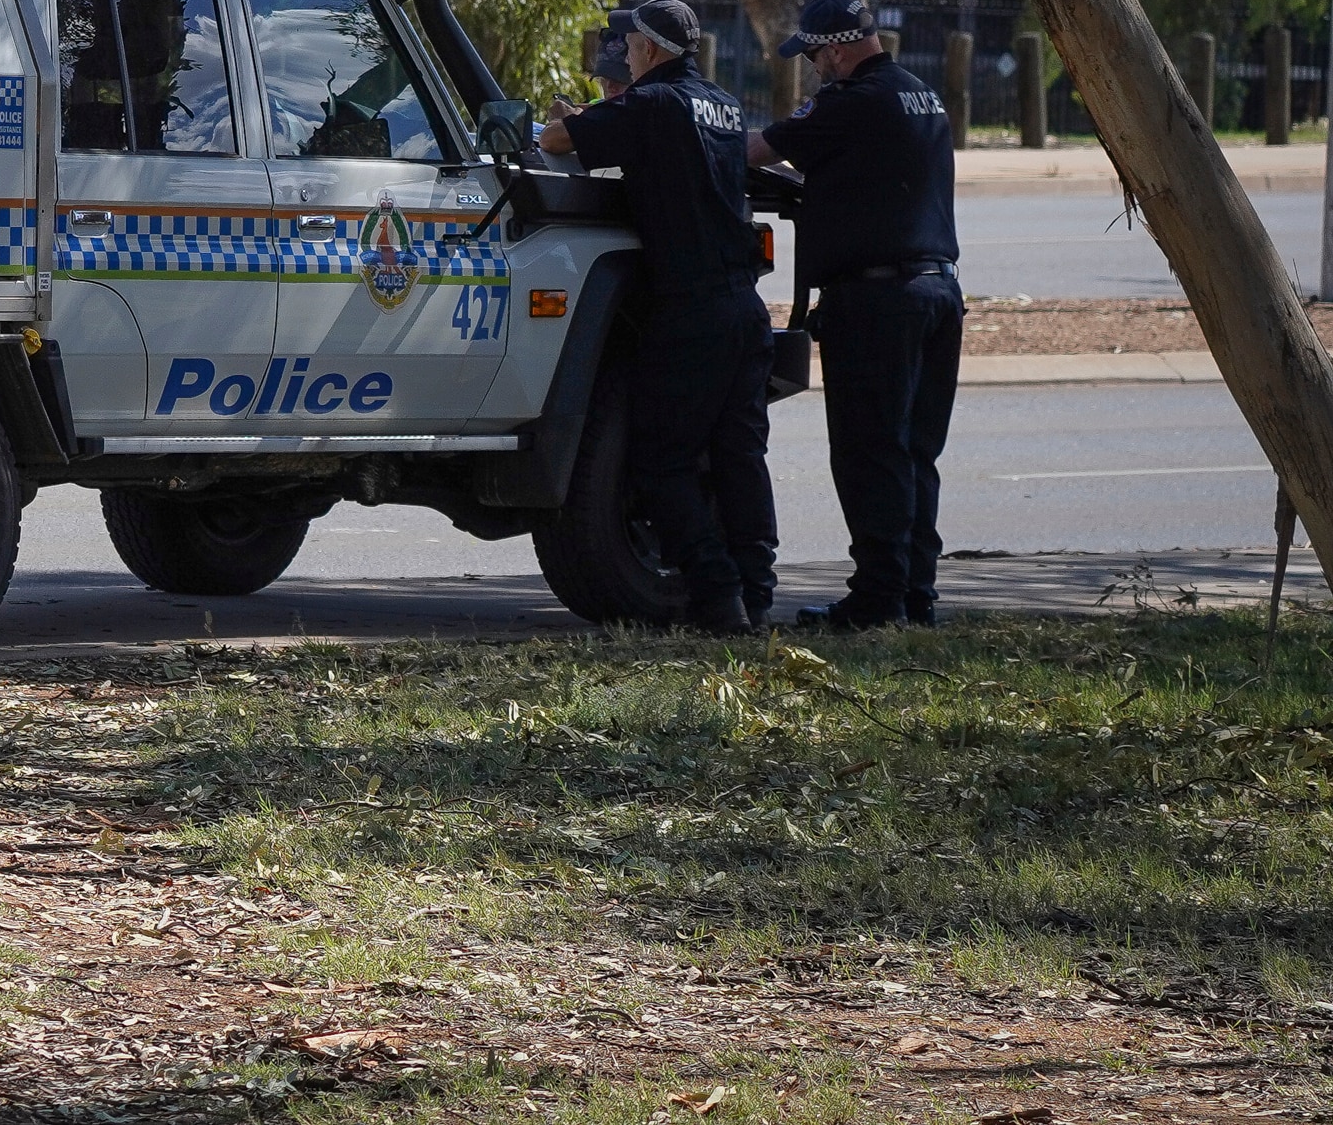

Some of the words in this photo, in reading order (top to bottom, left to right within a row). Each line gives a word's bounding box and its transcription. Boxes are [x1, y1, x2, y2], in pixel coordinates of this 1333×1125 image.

[691, 97, 744, 132] POLICE
[897, 91, 946, 115] POLICE
[378, 274, 403, 287] POLICE
[452, 285, 510, 341] 427
[154, 357, 394, 416] Police
